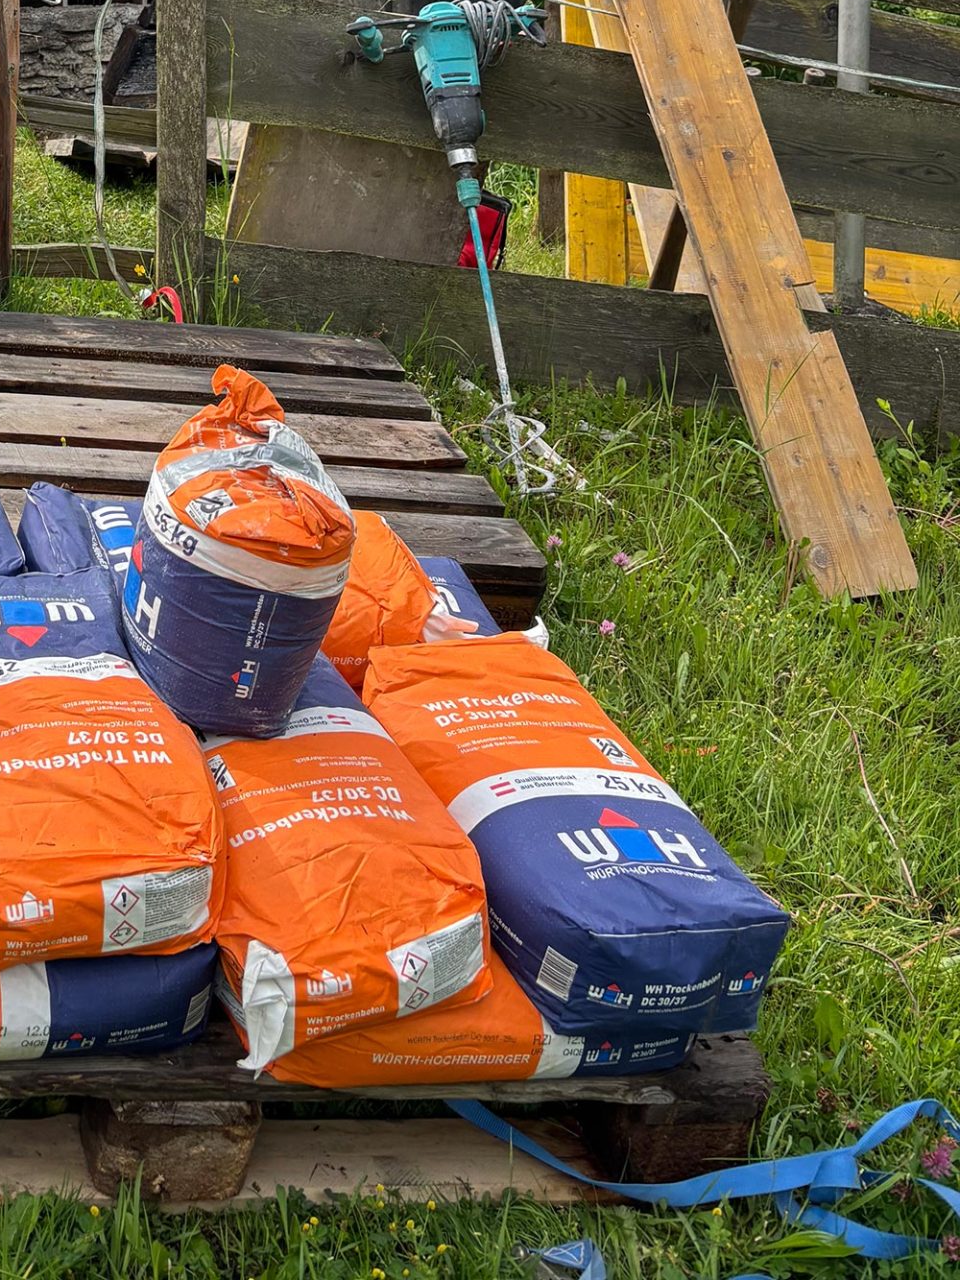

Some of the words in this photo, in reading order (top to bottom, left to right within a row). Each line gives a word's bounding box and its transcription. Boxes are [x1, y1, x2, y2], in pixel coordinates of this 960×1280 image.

[170, 521, 199, 556] kg
[422, 700, 457, 713] WH
[458, 691, 581, 708] Trockenbeton
[434, 713, 464, 728] DC
[468, 709, 518, 721] 30/37
[67, 731, 129, 746] 30/37
[135, 731, 164, 745] DC
[132, 750, 172, 765] WH
[514, 774, 578, 785] Qualitätsprodukt
[596, 774, 628, 791] 25
[631, 778, 667, 800] kg
[311, 787, 372, 803] 30/37
[372, 787, 402, 803] DC
[378, 806, 416, 822] WH
[230, 805, 378, 848] Trockenbeton
[557, 827, 707, 868] WH
[645, 983, 664, 995] WH
[665, 972, 722, 995] Trockenbeton
[641, 996, 656, 1006] DC
[656, 995, 688, 1007] 30/37
[306, 1016, 324, 1026] WH
[325, 1005, 386, 1024] Trockenbeton
[645, 1036, 680, 1049] Trockenbeton
[372, 1052, 531, 1066] WÜRTH-HOCHENBURGER
